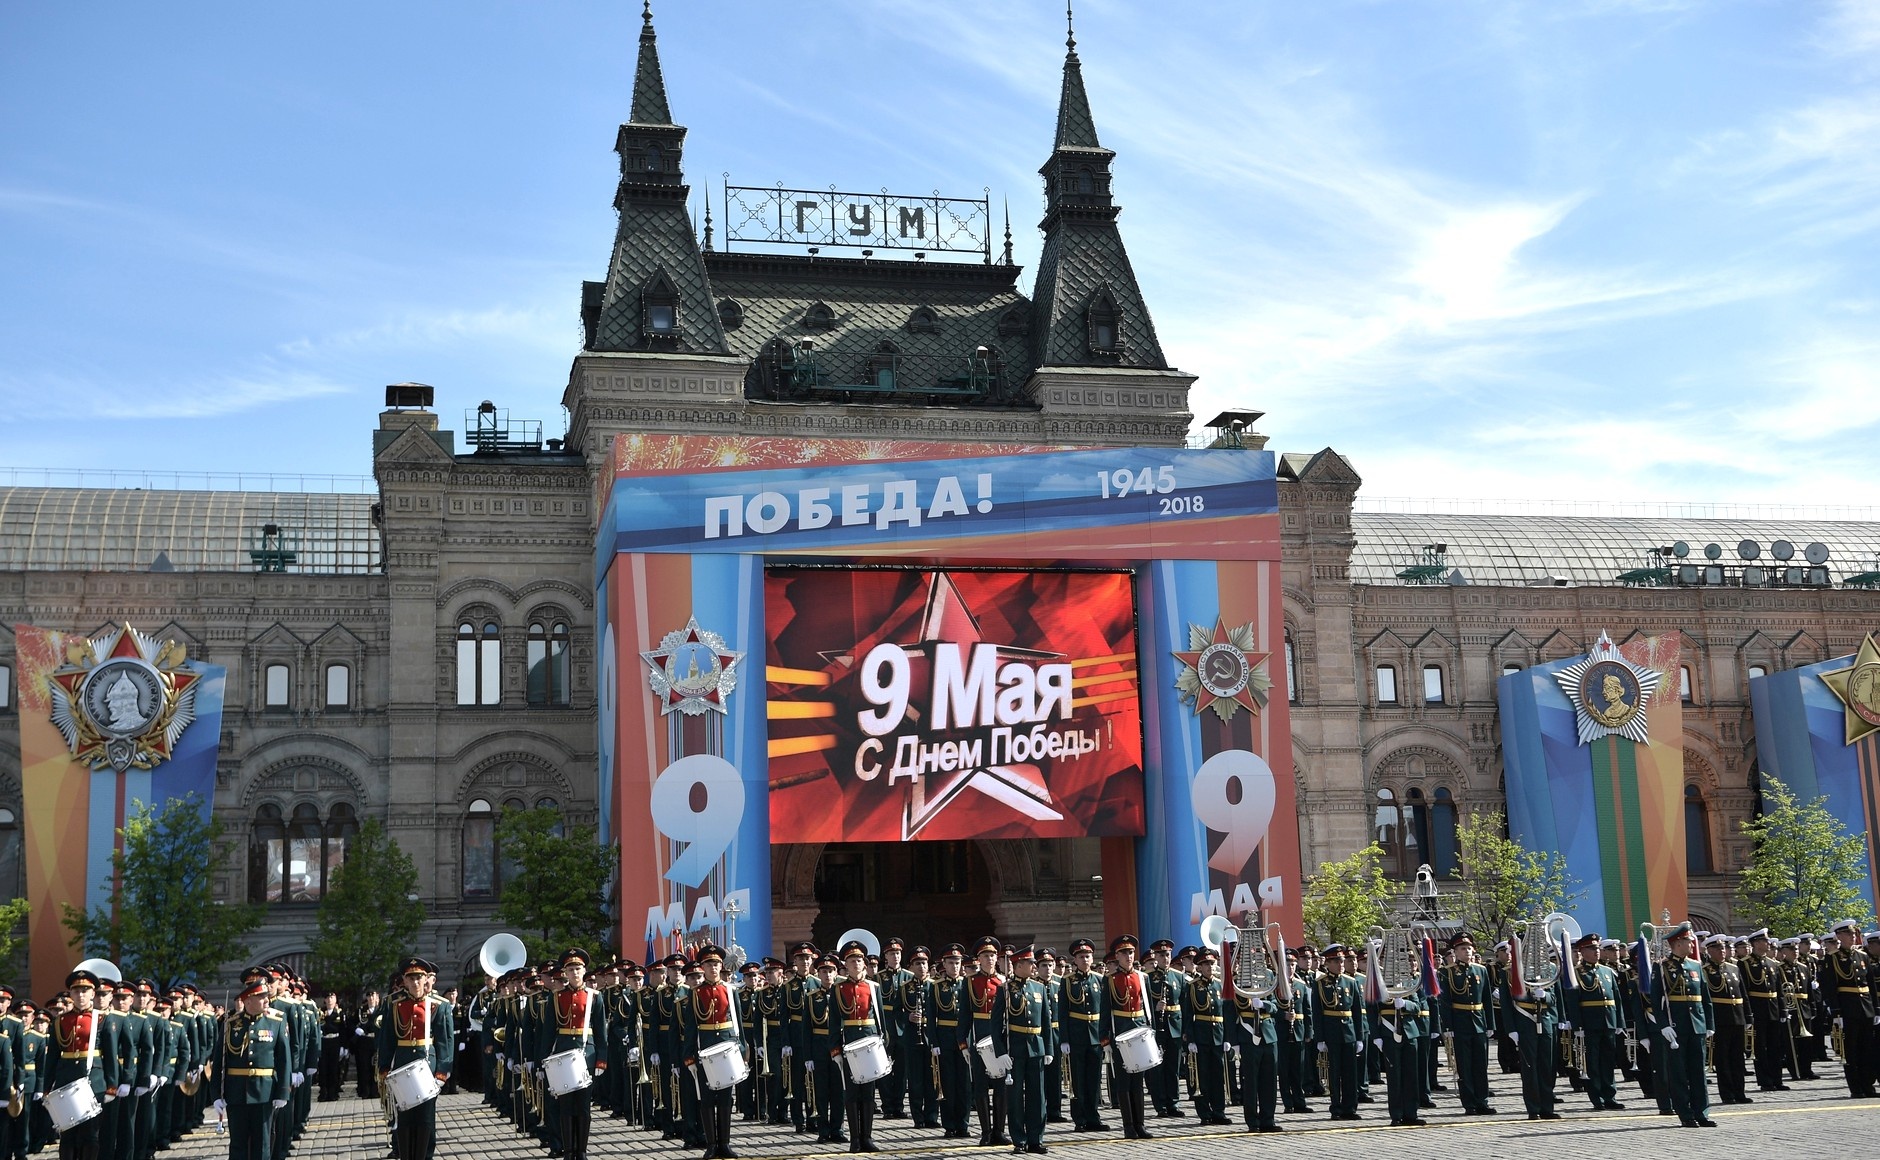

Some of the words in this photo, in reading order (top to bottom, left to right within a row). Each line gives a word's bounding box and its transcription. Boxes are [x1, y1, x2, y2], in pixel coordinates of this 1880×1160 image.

[796, 201, 924, 239] ГУМ
[705, 473, 993, 539] ПОБЕДА!
[1098, 465, 1176, 499] 1945
[1160, 495, 1205, 516] 2018
[857, 642, 910, 736] 9
[931, 642, 1073, 731] Мая
[1199, 644, 1244, 692] ОТЕЧЕСТВЕННАЯ
[1863, 710, 1880, 722] СЛ
[854, 738, 883, 782] С
[889, 735, 982, 786] Днем
[650, 754, 745, 888] 9
[1192, 750, 1276, 876] 9
[645, 888, 750, 942] МАЯ
[1190, 876, 1283, 925] МАЯ
